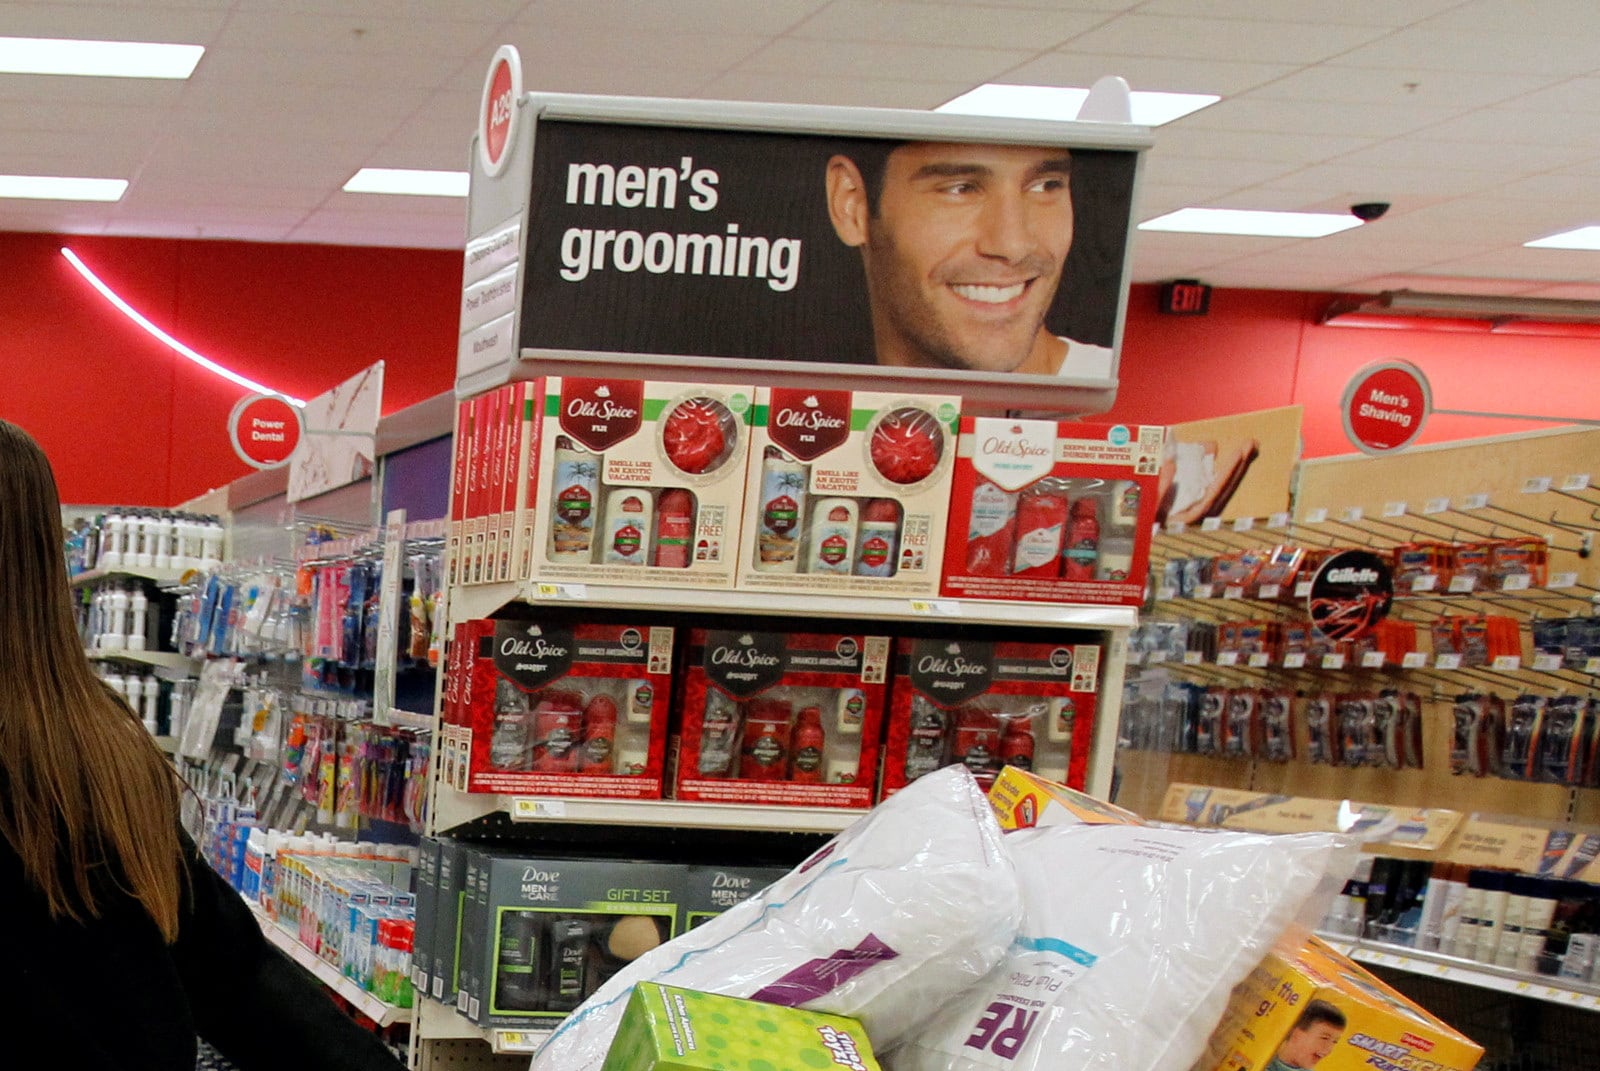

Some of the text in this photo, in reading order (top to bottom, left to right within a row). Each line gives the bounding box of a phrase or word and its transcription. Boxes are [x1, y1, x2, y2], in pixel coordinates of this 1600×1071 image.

[566, 157, 719, 210] men's
[560, 224, 800, 291] grooming
[568, 398, 635, 420] Old Spice
[1370, 389, 1409, 408] Men's
[252, 418, 285, 430] Power
[776, 408, 841, 430] Old Spice
[1359, 404, 1412, 427] Shaving
[252, 431, 285, 442] Dental
[982, 437, 1048, 459] Old Spice
[1327, 567, 1379, 584] Gillette
[501, 637, 565, 659] Old Spice
[711, 646, 777, 668] Old Spice
[918, 655, 984, 676] Old Spice
[521, 866, 560, 882] Dove
[712, 872, 750, 888] Dove
[522, 884, 547, 892] MEN
[607, 889, 671, 901] GIFT SET
[711, 890, 737, 898] MEN
[1277, 981, 1300, 1006] the
[1348, 1032, 1409, 1061] SMART
